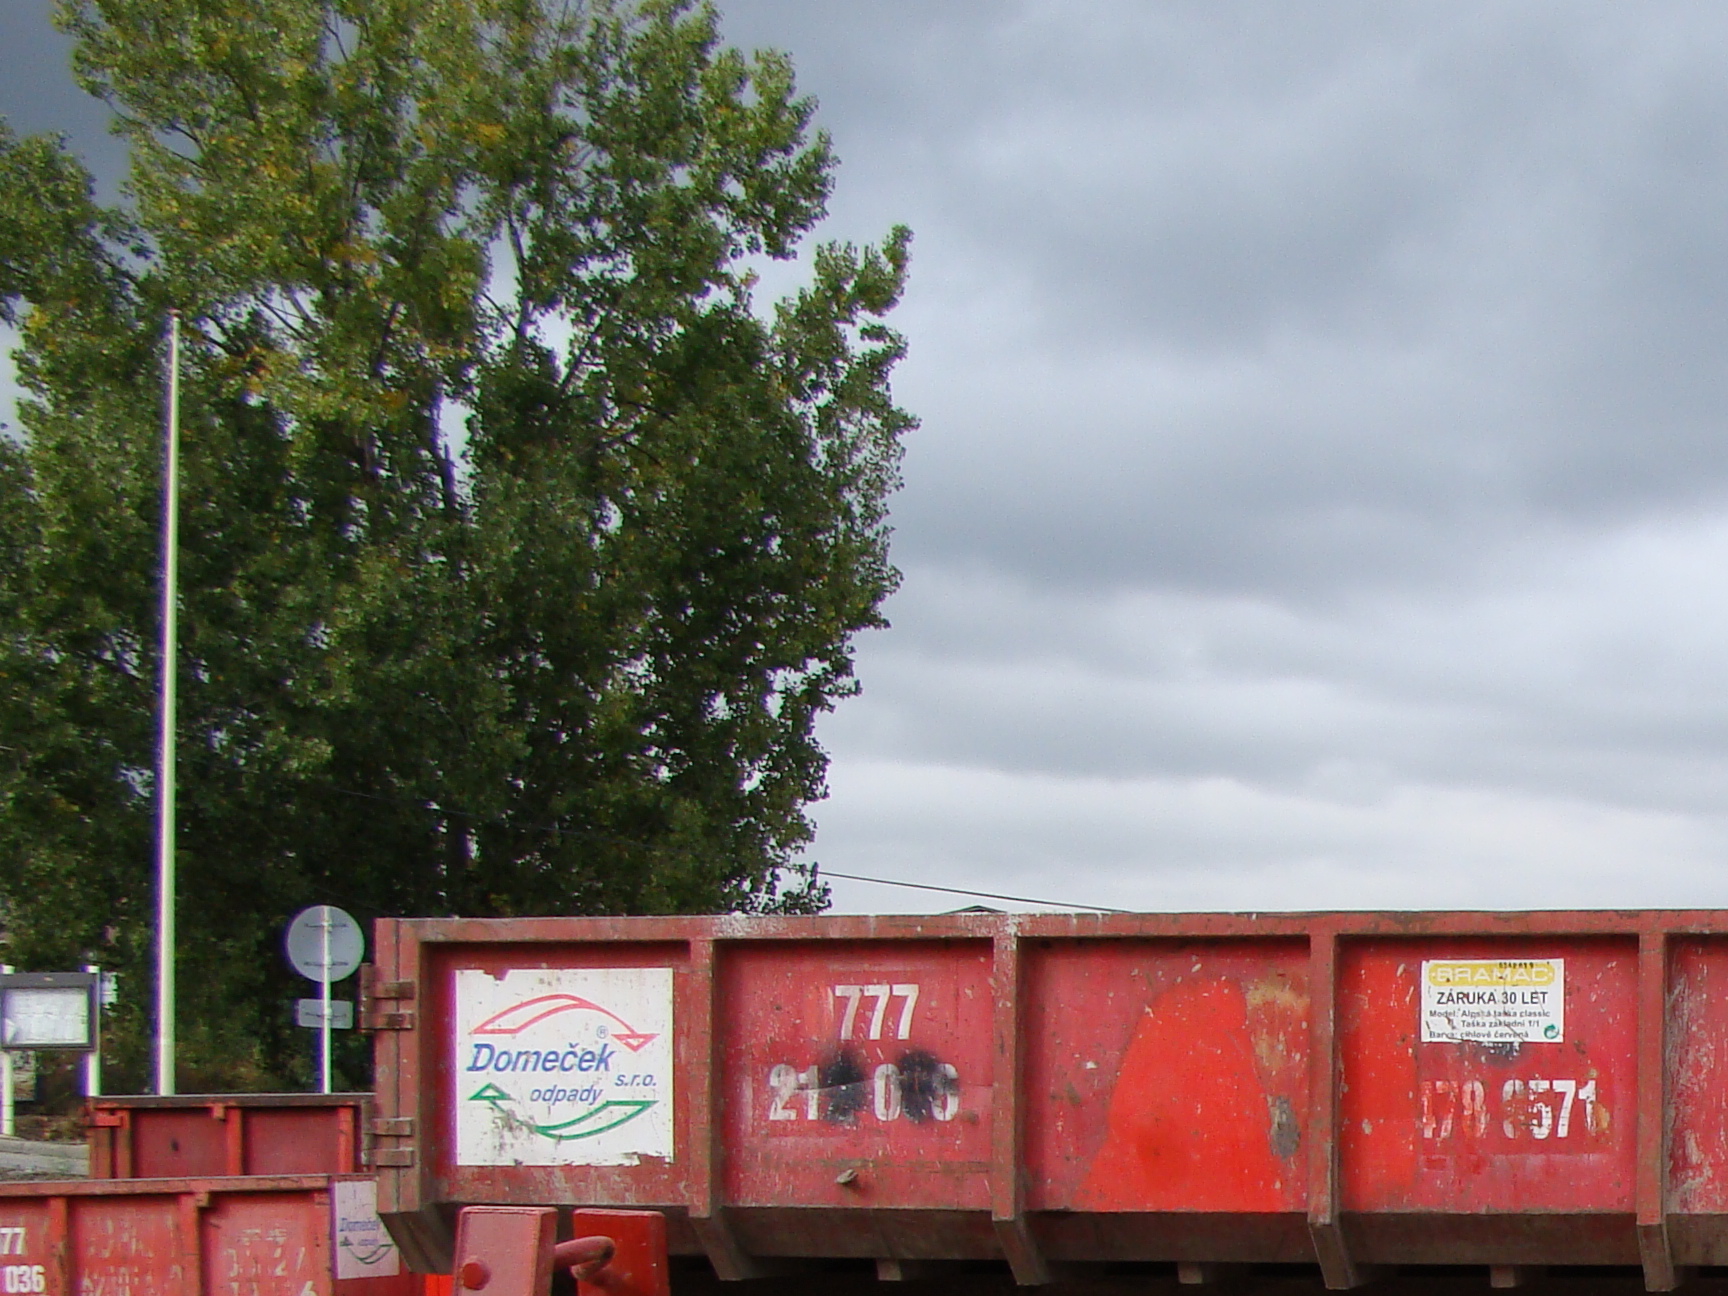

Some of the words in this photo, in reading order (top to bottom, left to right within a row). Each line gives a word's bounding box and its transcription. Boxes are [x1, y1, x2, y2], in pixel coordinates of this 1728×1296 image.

[1436, 967, 1550, 983] BRAMAC
[1436, 988, 1497, 1005] ZÁRUKA
[1501, 991, 1518, 1005] 30
[1521, 991, 1549, 1005] LET
[834, 983, 920, 1040] 777
[466, 1042, 616, 1073] Domeček
[614, 1073, 658, 1087] s.r.o.
[529, 1085, 604, 1106] odpady
[6, 1264, 46, 1294] 036
